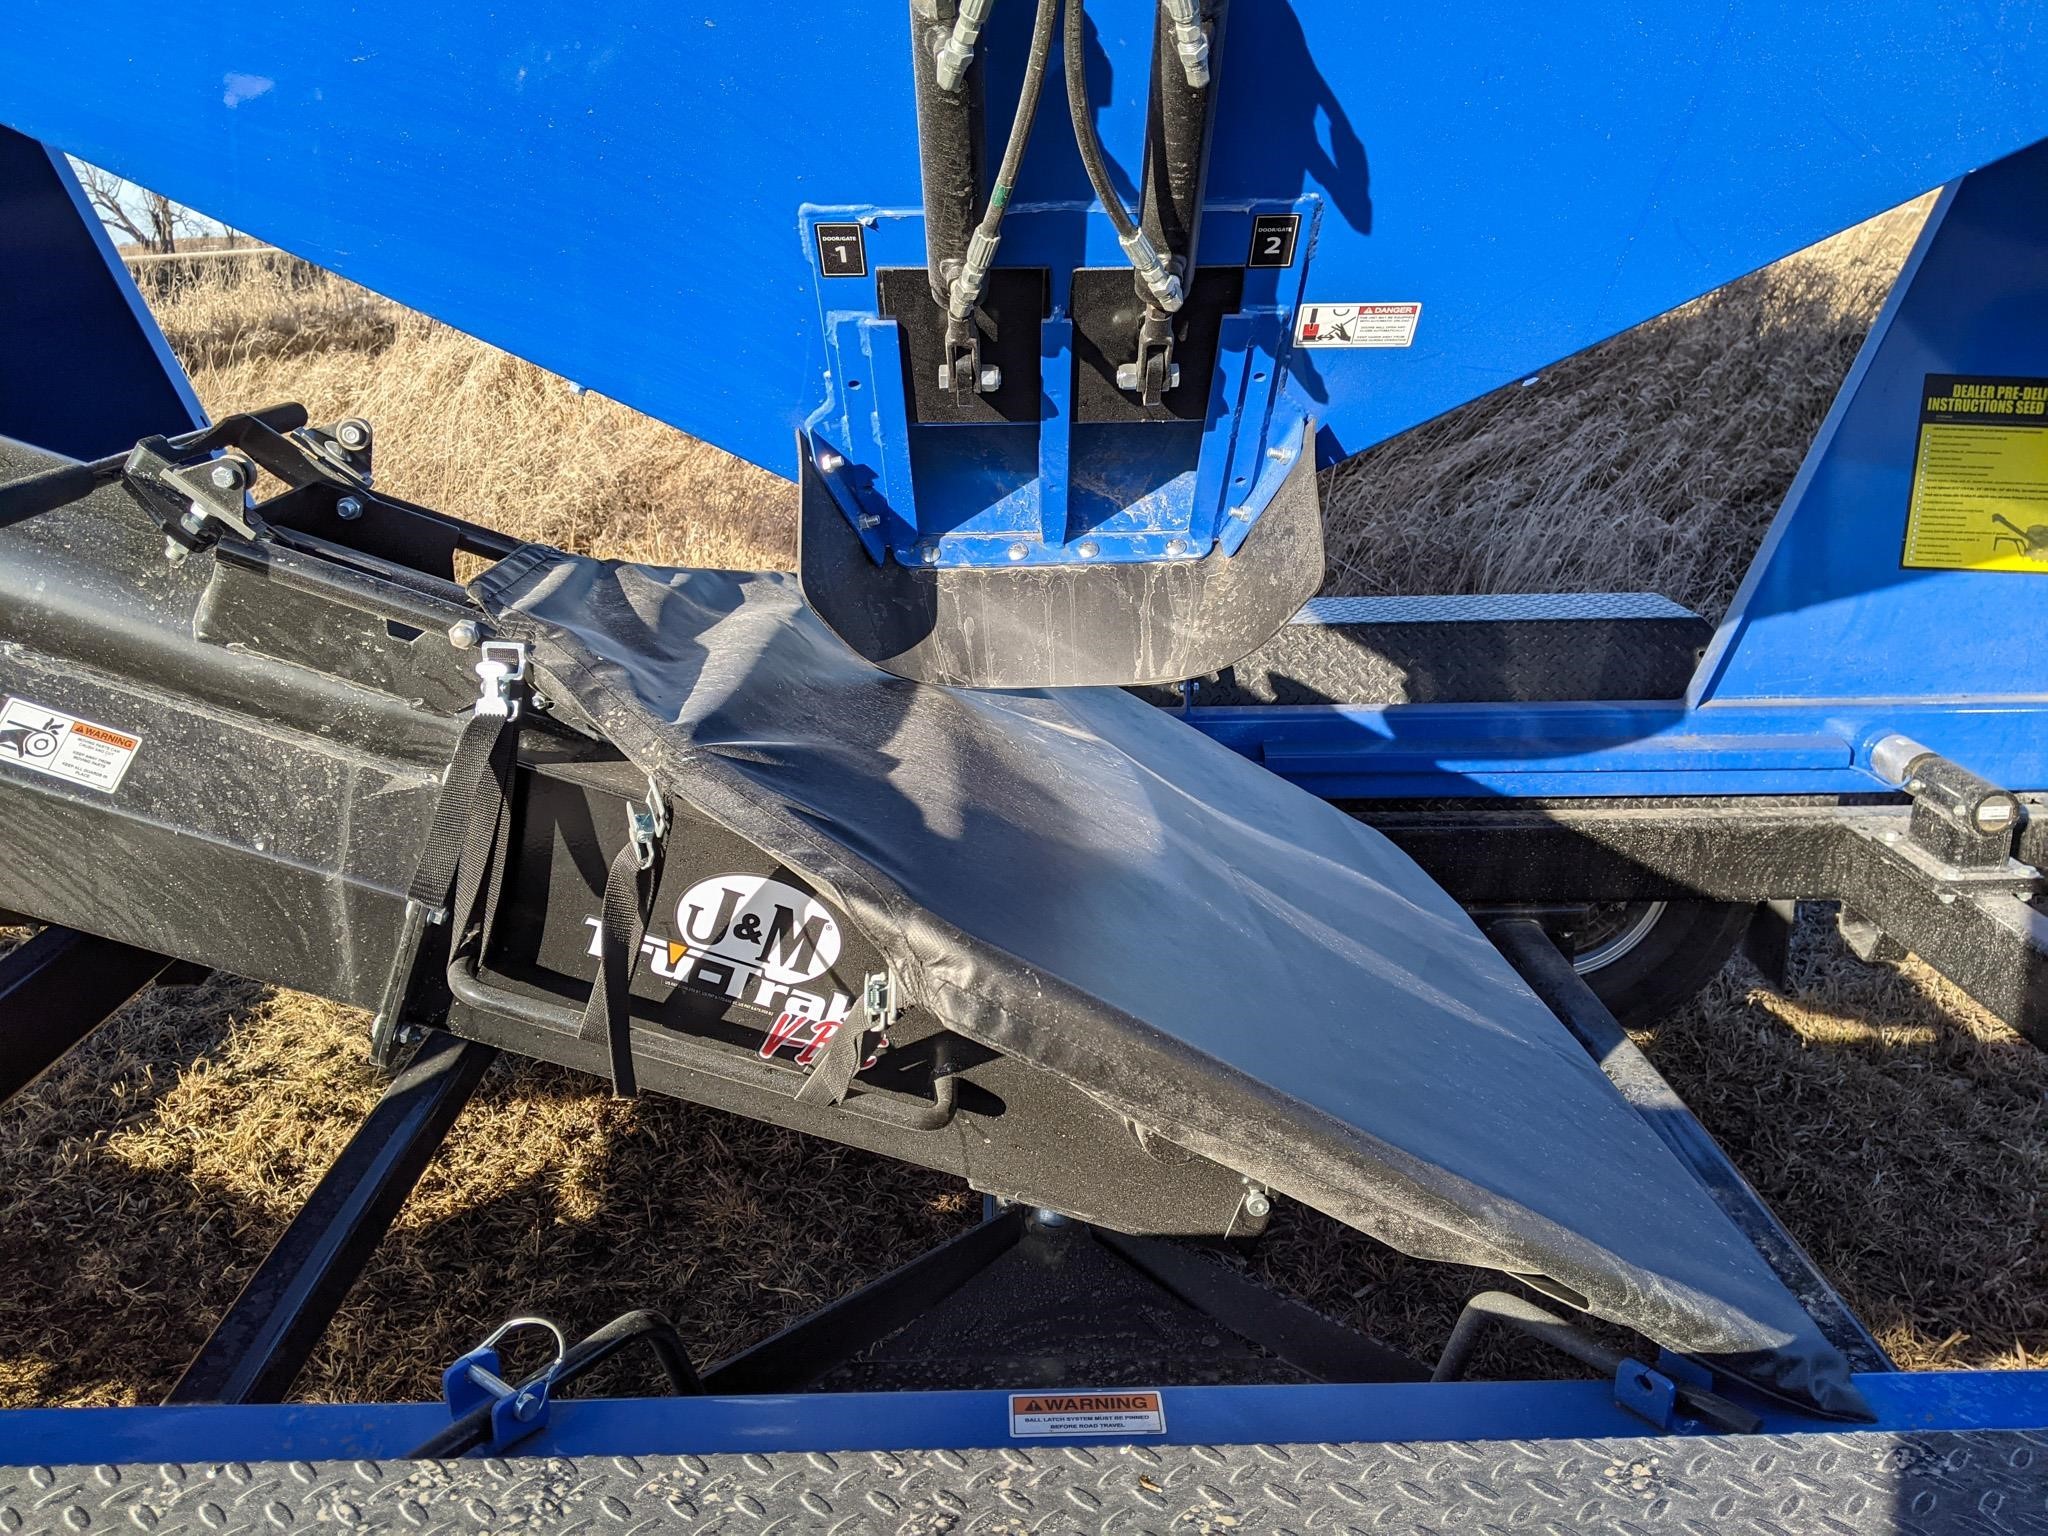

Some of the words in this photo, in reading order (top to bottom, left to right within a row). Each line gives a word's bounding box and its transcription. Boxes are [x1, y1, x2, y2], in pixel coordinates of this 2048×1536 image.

[834, 245, 847, 263] 1
[1264, 236, 1282, 254] 2
[1374, 306, 1412, 314] DANGER
[1952, 384, 1995, 399] DEALER
[1927, 397, 2014, 414] INSTRUCTIONS
[2015, 401, 2045, 415] SEED
[86, 727, 133, 748] WARNING
[1045, 1397, 1148, 1411] WARNING
